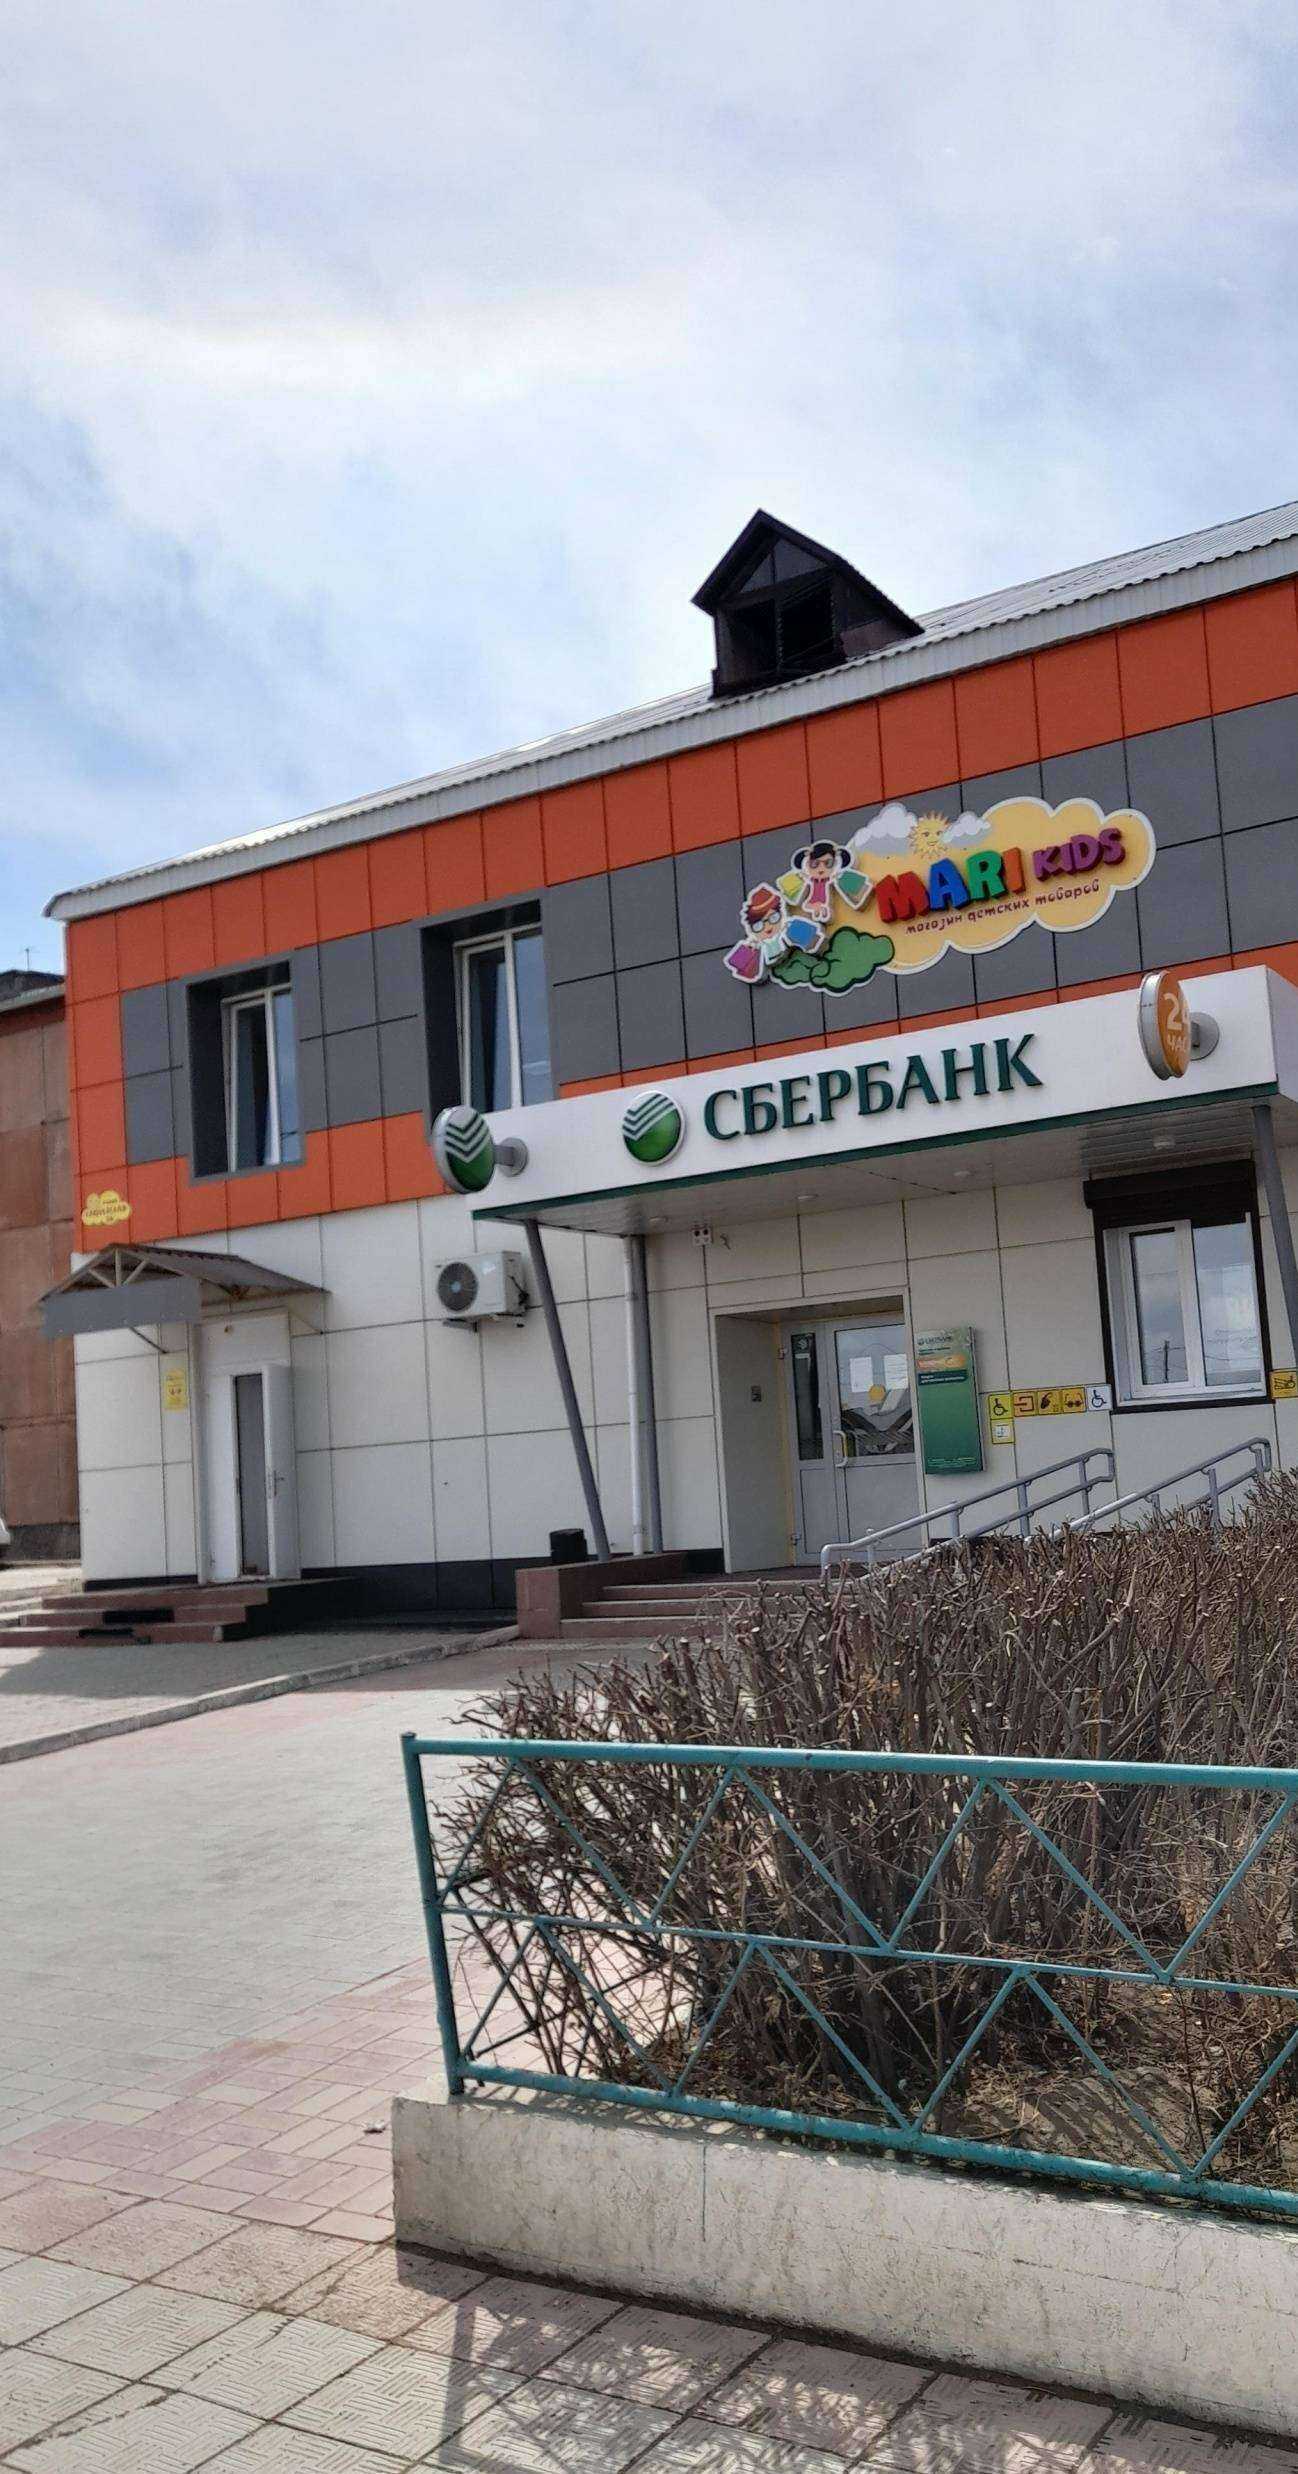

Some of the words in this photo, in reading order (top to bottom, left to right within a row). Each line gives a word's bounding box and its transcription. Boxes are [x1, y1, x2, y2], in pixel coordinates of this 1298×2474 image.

[874, 846, 1026, 923] MARI
[1032, 828, 1126, 881] KIDS
[704, 1033, 1043, 1140] СБЕРБАНК
